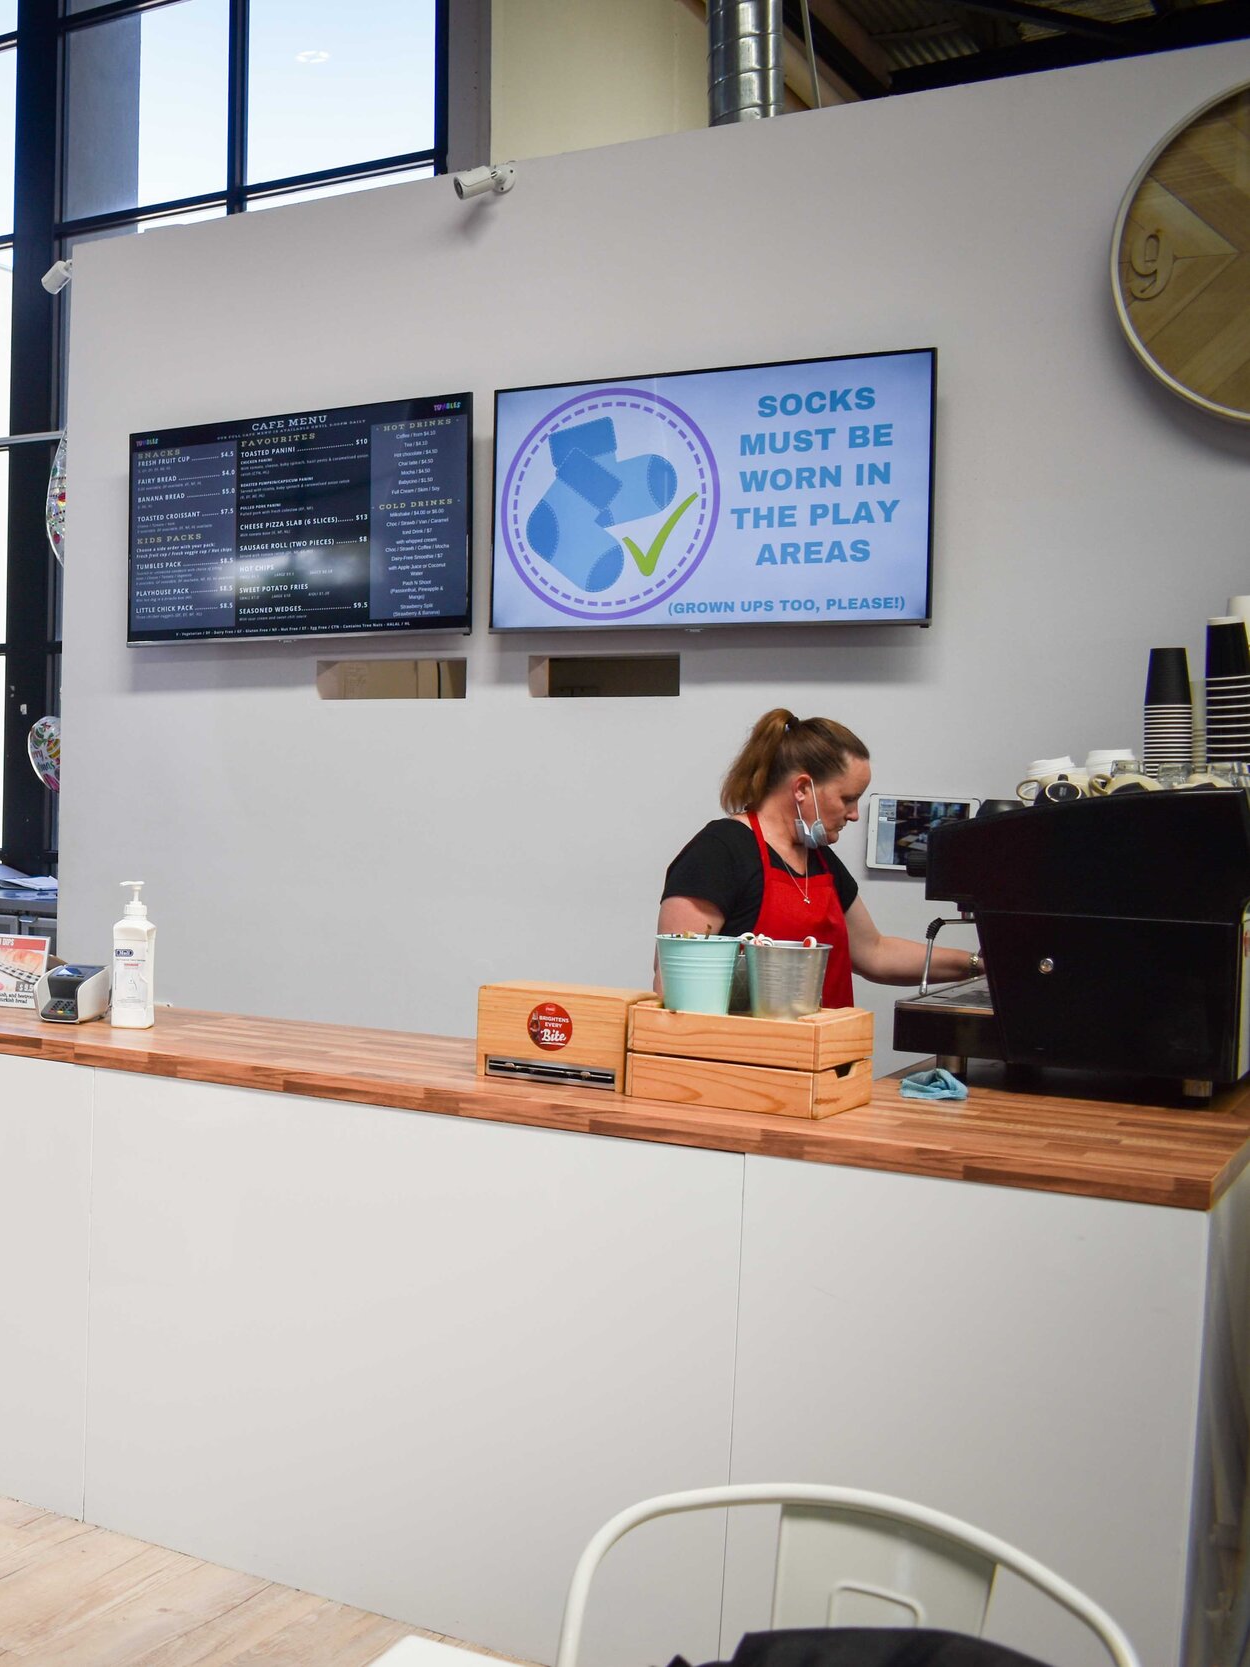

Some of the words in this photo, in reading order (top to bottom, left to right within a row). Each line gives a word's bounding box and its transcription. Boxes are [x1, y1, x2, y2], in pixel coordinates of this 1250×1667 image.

[1130, 229, 1173, 300] 9
[758, 387, 875, 417] SOCKS
[252, 421, 284, 431] CAFE
[289, 415, 327, 427] MENU
[383, 424, 405, 432] HOT
[410, 419, 451, 428] DRINKS
[241, 433, 316, 447] FAVOURITES
[740, 427, 836, 456] MUST
[849, 424, 893, 448] BE
[138, 449, 180, 459] SNACKS
[241, 450, 269, 458] TOASTED
[272, 447, 295, 455] PANINI
[138, 459, 156, 467] FRESH
[159, 457, 176, 465] FRUIT
[138, 477, 155, 485] FAIRY
[739, 465, 841, 492] WORN
[856, 462, 891, 486] IN
[138, 495, 163, 503] BANANA
[379, 502, 406, 510] COLD
[411, 499, 453, 507] DRINKS
[137, 514, 164, 522] TOASTED
[166, 512, 200, 520] CROISSANT
[731, 505, 797, 529] THE
[810, 500, 900, 526] PLAY
[240, 522, 264, 530] CHEESE
[304, 518, 311, 526] (6
[137, 536, 162, 544] KIDS
[167, 533, 202, 542] PACKS
[309, 538, 334, 546] PIECES)
[756, 540, 871, 566] AREAS
[136, 562, 164, 570] TUMBLES
[136, 589, 171, 597] PLAYHOUSE
[239, 586, 260, 594] SWEET
[239, 607, 273, 615] SEASONED
[668, 601, 734, 616] (GROWN
[741, 600, 774, 612] UPS
[780, 600, 820, 613] TOO,
[826, 596, 905, 611] PLEASE!)
[2, 938, 14, 946] DIPS
[541, 1029, 566, 1041] Bite
